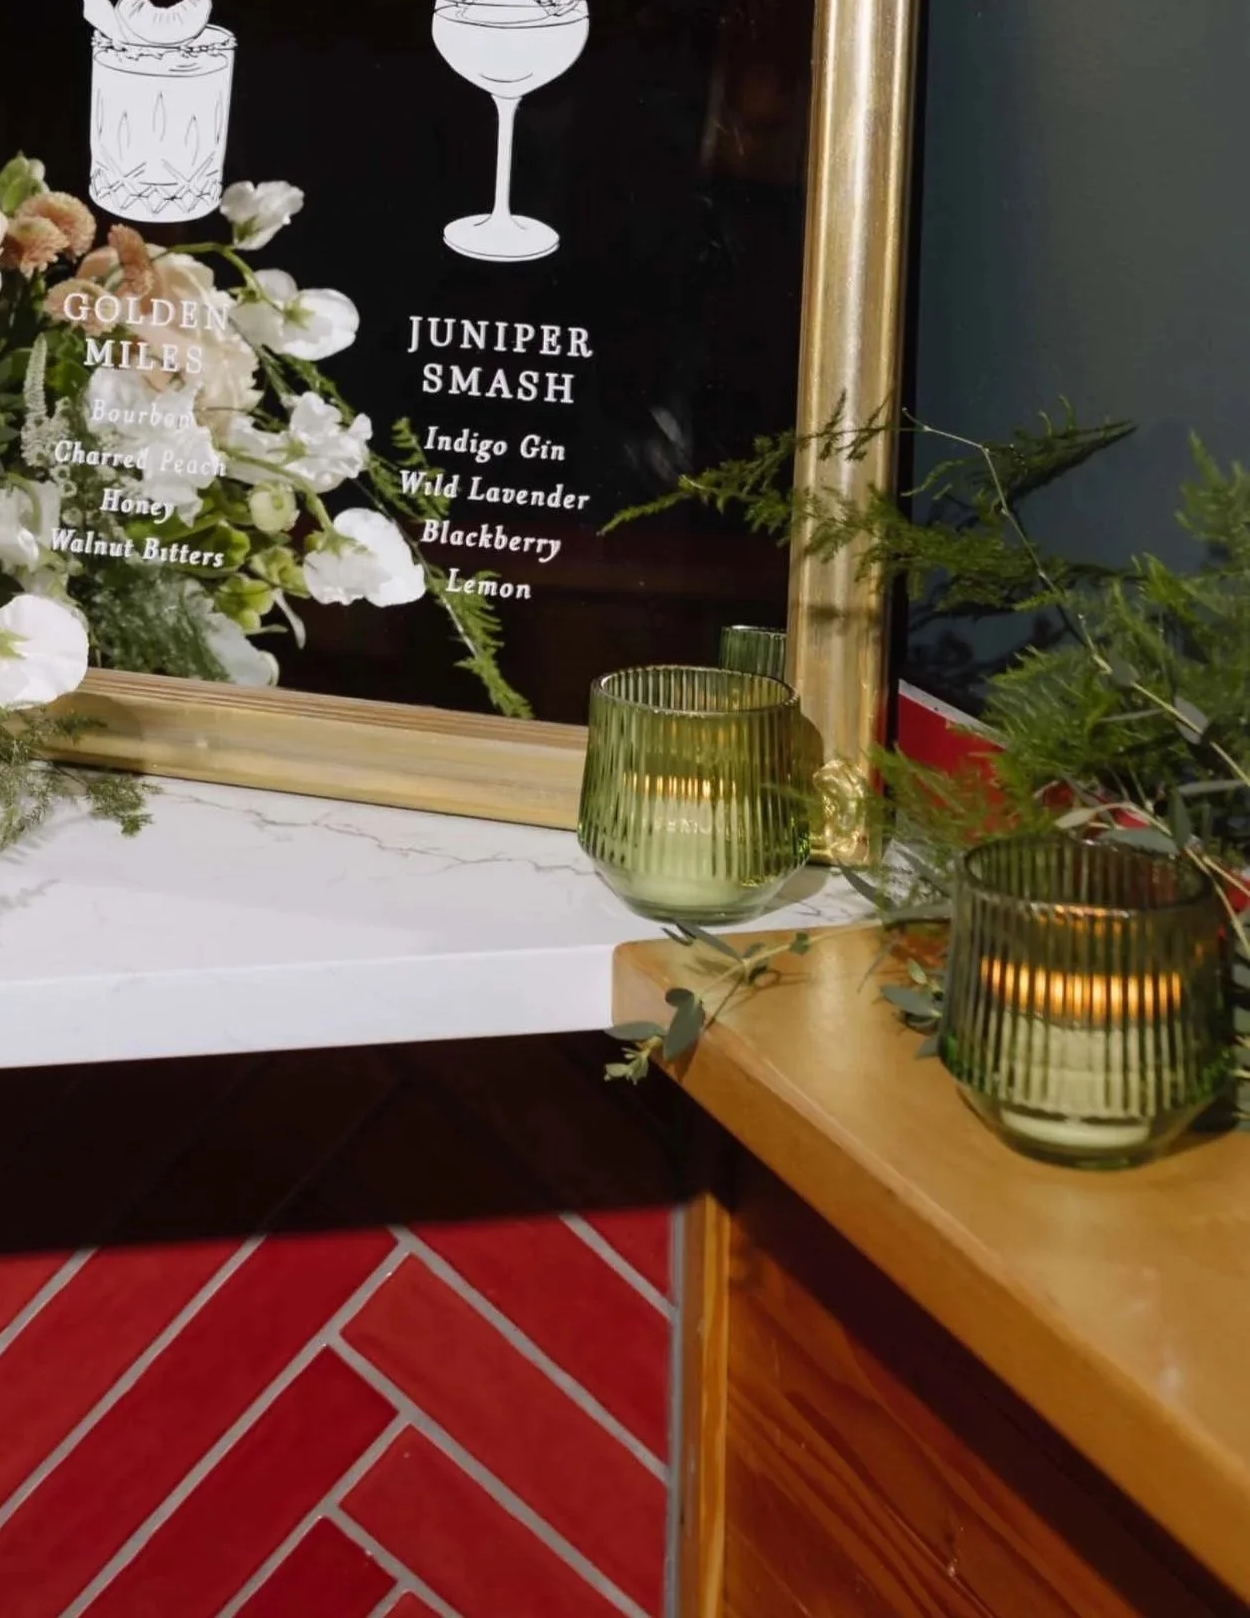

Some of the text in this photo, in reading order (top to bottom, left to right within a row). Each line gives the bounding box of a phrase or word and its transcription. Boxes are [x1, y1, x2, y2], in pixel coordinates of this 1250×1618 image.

[63, 293, 231, 330] GOLDEN
[407, 316, 593, 358] JUNIPER
[83, 338, 202, 374] MILES
[422, 363, 574, 403] SMASH
[92, 399, 193, 428] Bourbon
[55, 440, 226, 477] Charred Peach
[424, 425, 565, 463] Indigo Gin
[100, 488, 174, 524] Honey
[399, 469, 590, 510] Wild Lavender
[50, 528, 224, 568] Walnut Bitters
[420, 519, 561, 563] Blackberry
[446, 568, 531, 599] Lemon
